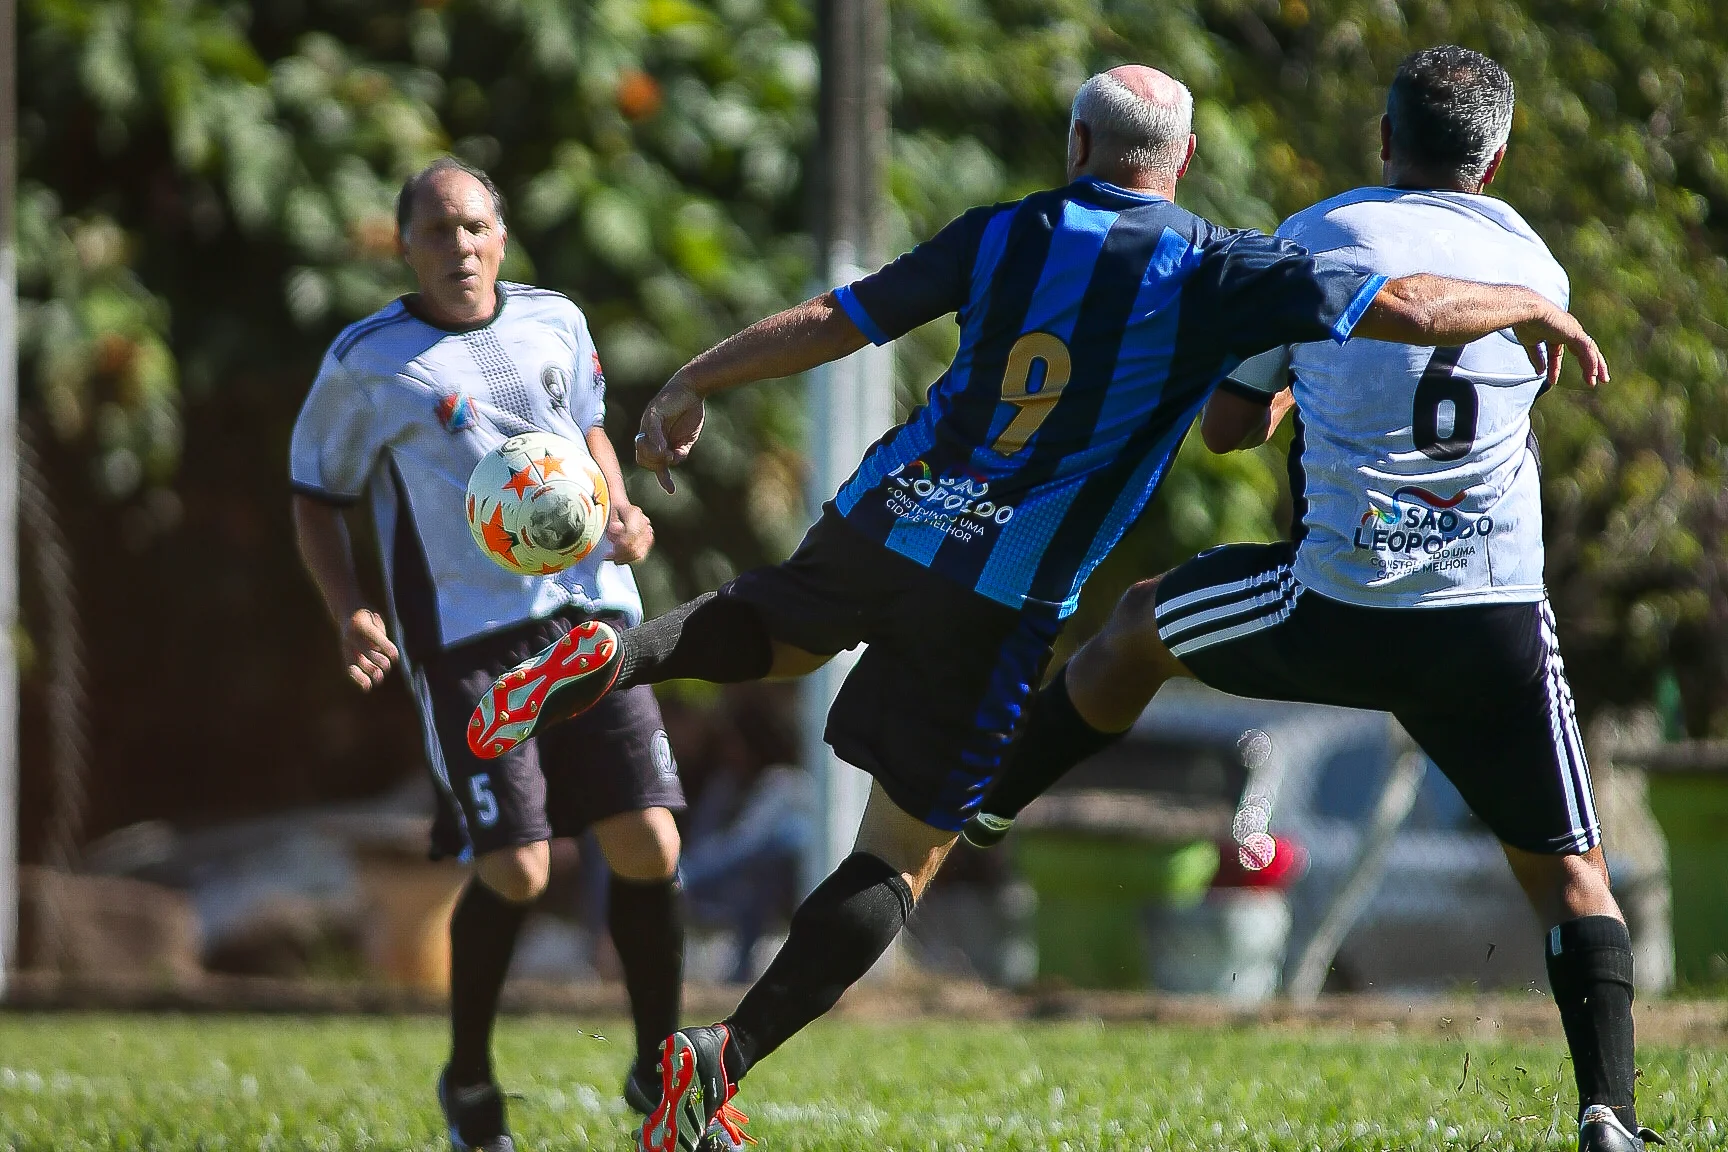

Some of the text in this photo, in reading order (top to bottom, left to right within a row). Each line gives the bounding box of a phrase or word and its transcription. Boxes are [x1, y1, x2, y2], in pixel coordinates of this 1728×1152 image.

[991, 332, 1071, 456] 9
[1412, 345, 1478, 461] 6
[888, 463, 1014, 524] LOPOLDO
[960, 517, 985, 536] UMA
[1353, 516, 1493, 554] LEOPODO
[1422, 558, 1468, 574] MELHOR
[1452, 546, 1476, 558] UMA
[468, 773, 499, 827] 5
